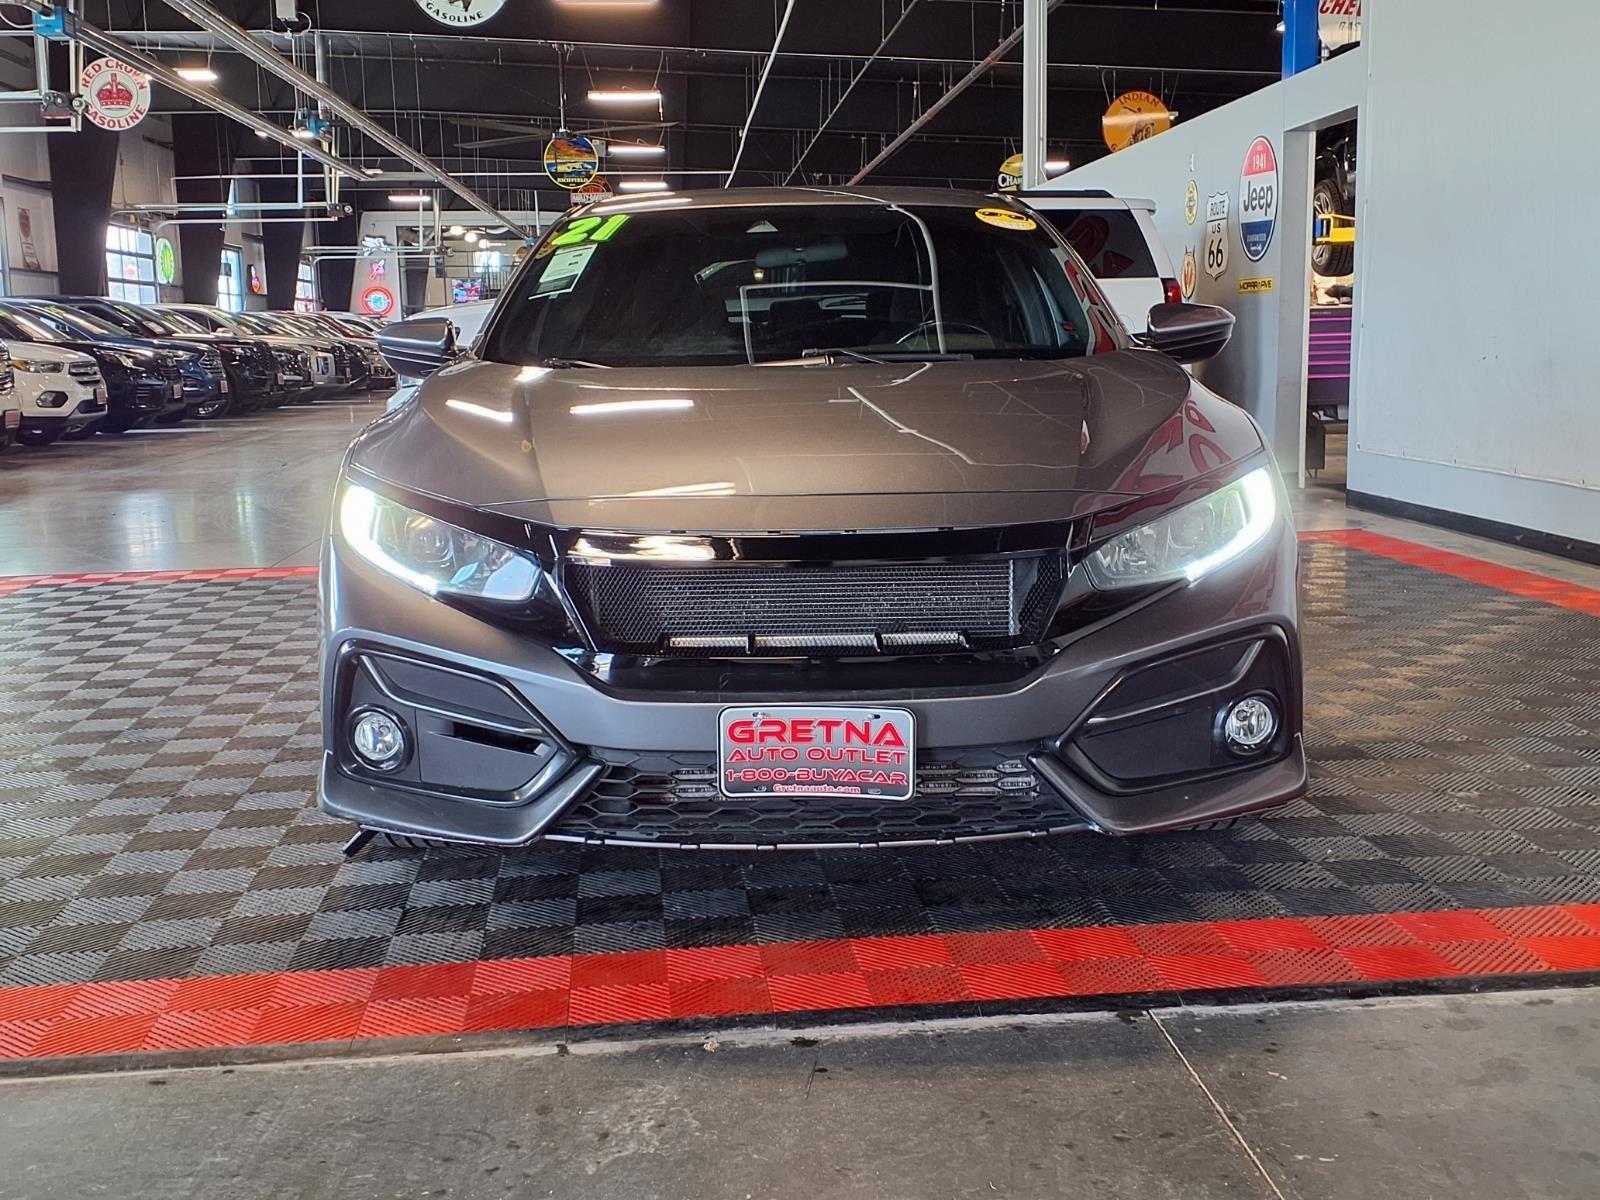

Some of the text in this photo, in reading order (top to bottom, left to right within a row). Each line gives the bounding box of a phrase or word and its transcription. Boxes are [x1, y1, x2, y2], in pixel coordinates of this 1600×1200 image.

[426, 2, 483, 22] GASOLINE
[82, 63, 102, 88] RED
[1119, 93, 1159, 107] INDIAN
[1252, 154, 1266, 170] 1941
[1243, 180, 1273, 216] Jeep
[1210, 200, 1225, 216] ROUTE
[552, 214, 630, 246] 21
[1211, 223, 1221, 234] US
[1208, 238, 1223, 269] 66
[727, 719, 906, 747] GRETNA
[727, 747, 908, 765] AUTO OUTLET
[726, 768, 908, 785] 1-800-BUYACAR
[773, 784, 861, 794] Gretnaauto.com
